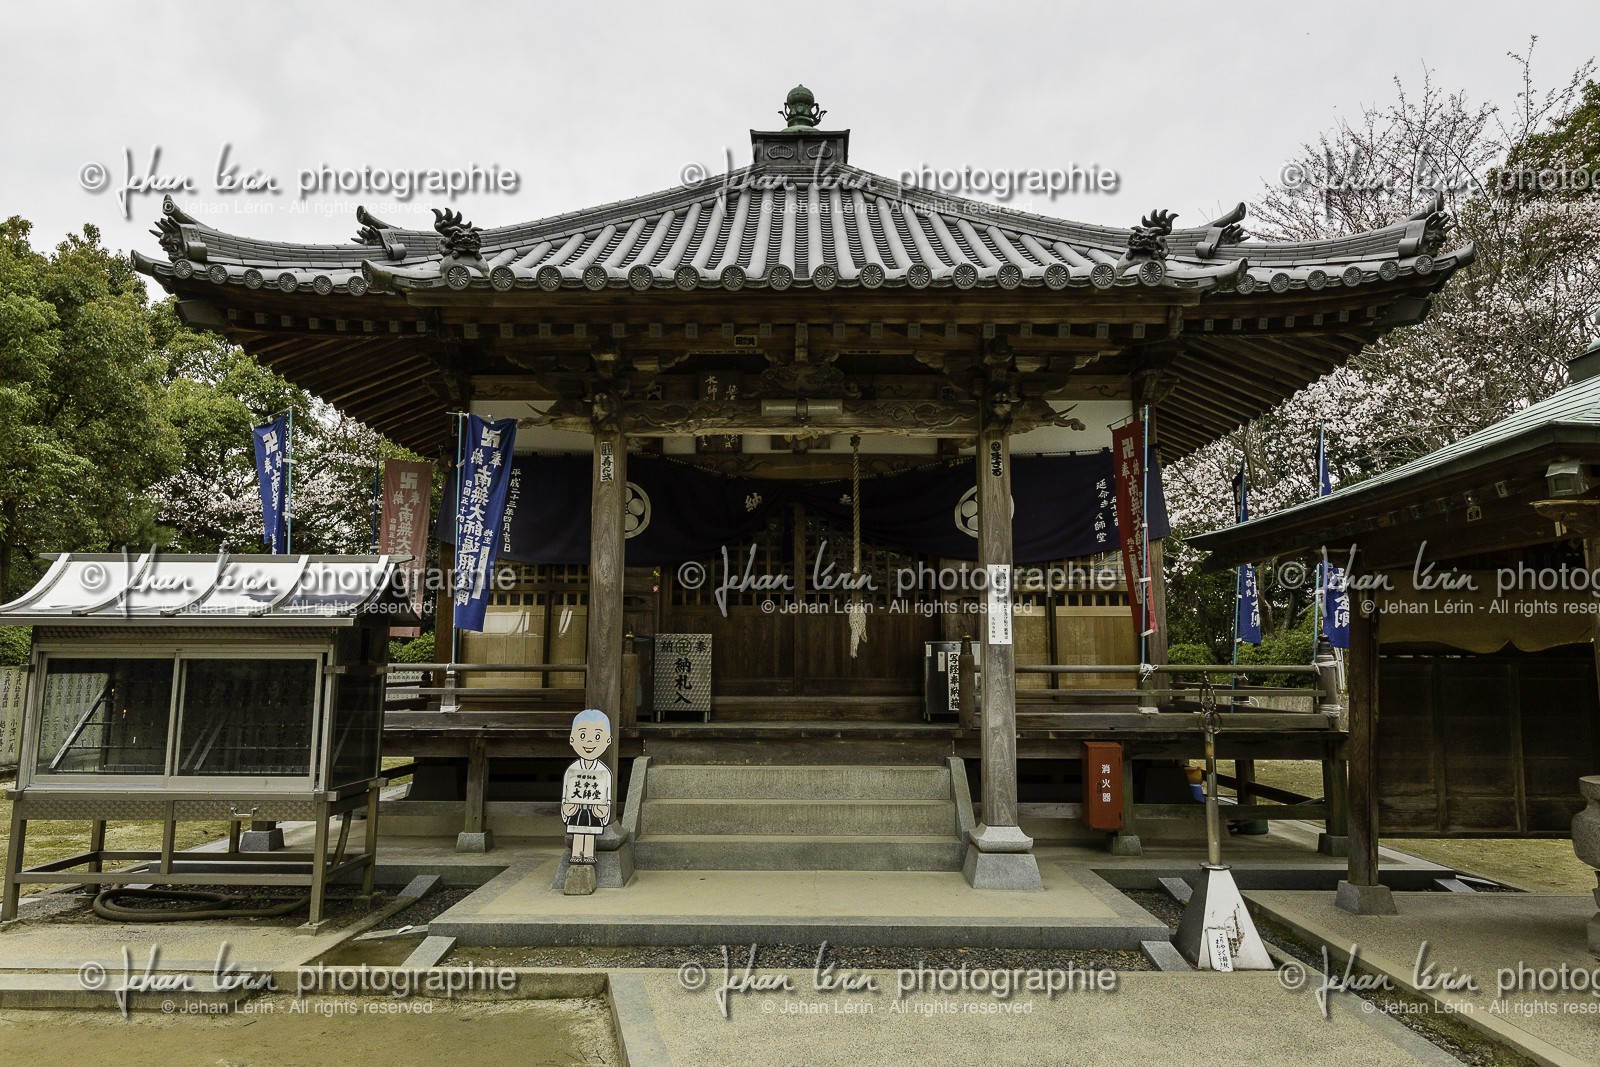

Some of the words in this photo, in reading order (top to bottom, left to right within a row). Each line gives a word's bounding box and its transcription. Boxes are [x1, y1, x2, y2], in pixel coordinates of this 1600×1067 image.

[503, 468, 522, 553] 平成二十三年四月吉日
[673, 657, 693, 704] 納札入
[571, 788, 601, 800] 大師堂
[574, 781, 599, 790] 延命寺
[1101, 764, 1111, 803] 消火器
